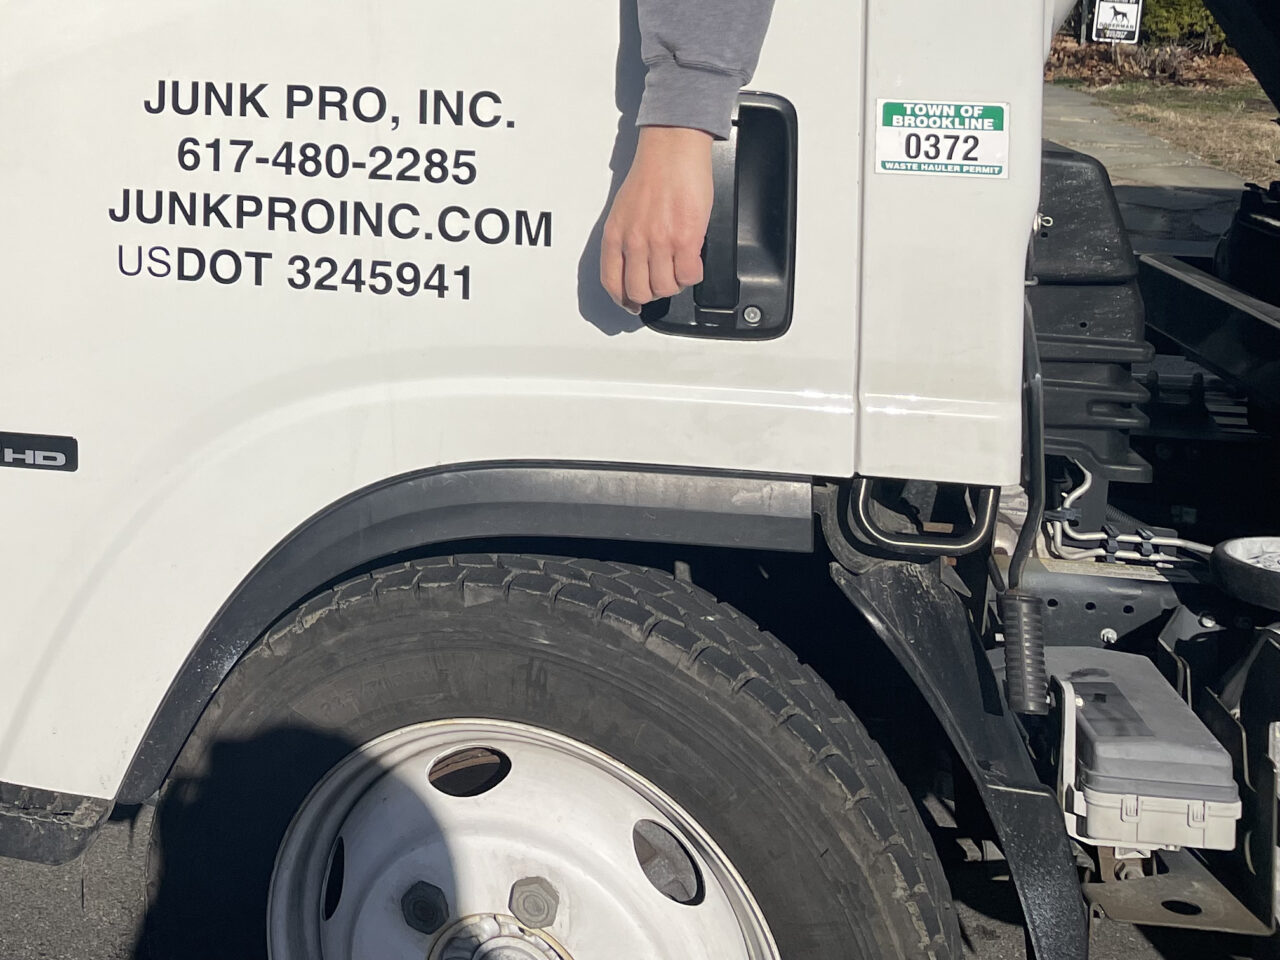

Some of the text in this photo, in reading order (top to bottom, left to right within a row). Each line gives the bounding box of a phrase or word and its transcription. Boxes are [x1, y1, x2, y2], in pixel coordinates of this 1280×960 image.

[143, 79, 516, 131] JUNK PRO, INC.
[903, 103, 983, 118] TOWN OF
[892, 115, 994, 130] BROOKLINE
[177, 137, 477, 185] 617-480-2285
[904, 132, 980, 161] 0372
[885, 161, 1000, 174] WASTE HAULER PERMIT
[108, 188, 552, 247] JUNKPROINC.COM
[118, 244, 471, 300] USDOT 3245941
[3, 448, 66, 467] HD
